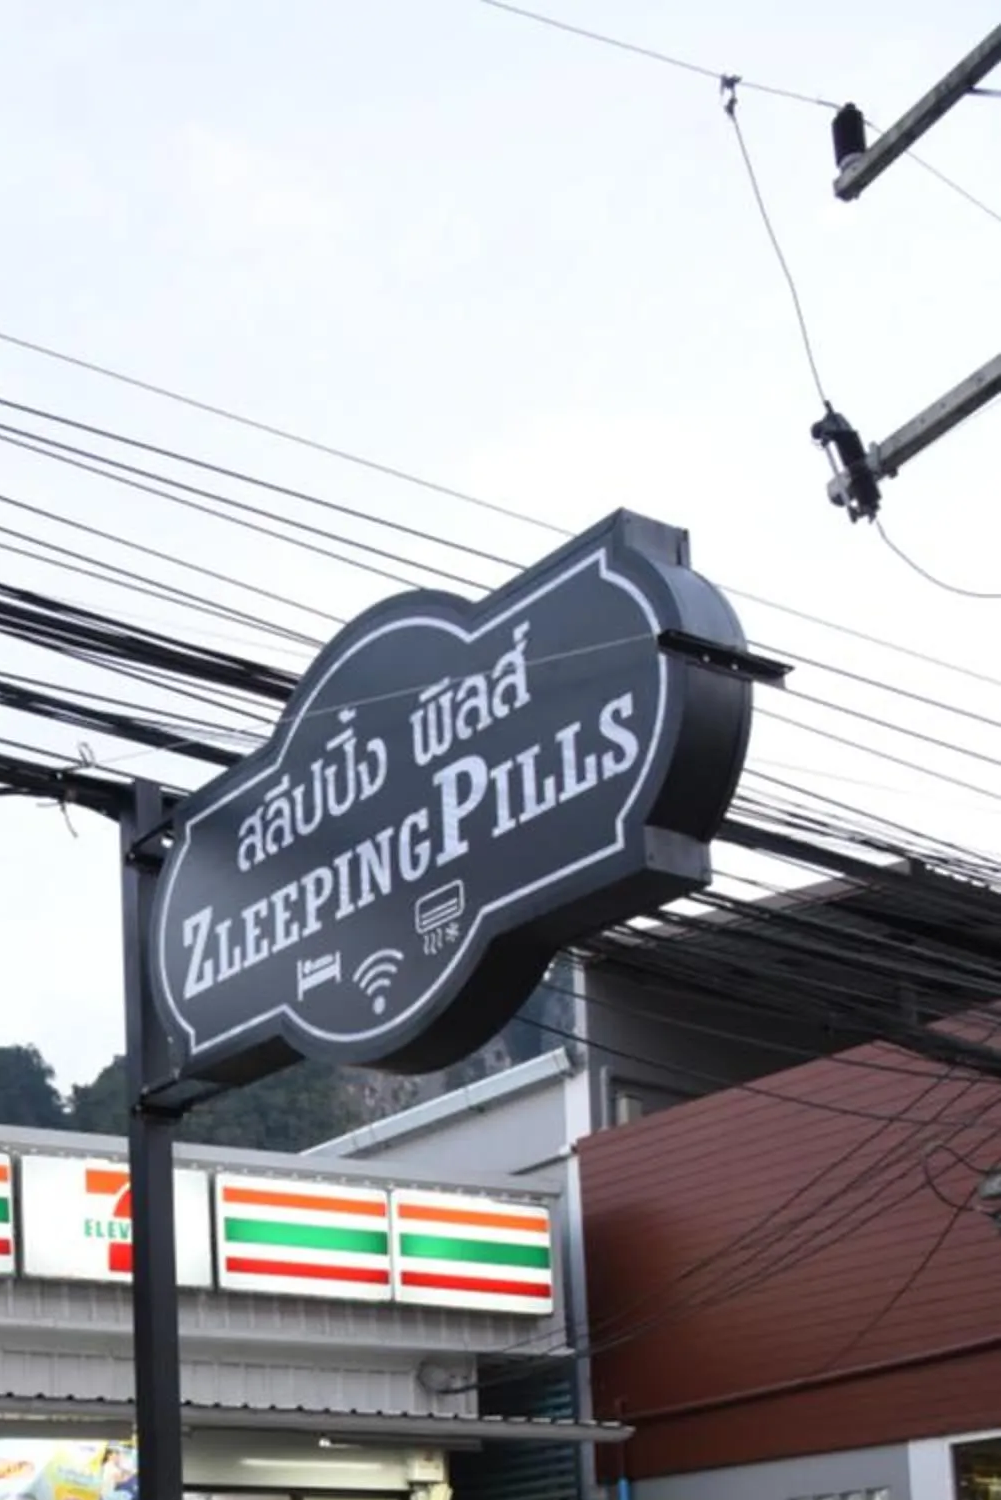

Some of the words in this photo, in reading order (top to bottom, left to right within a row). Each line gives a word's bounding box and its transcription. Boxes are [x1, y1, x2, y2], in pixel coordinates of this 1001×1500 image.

[182, 813, 432, 1000] ZLEEPING
[432, 692, 640, 867] PILLS
[237, 708, 388, 873] สลีปปิ้ง
